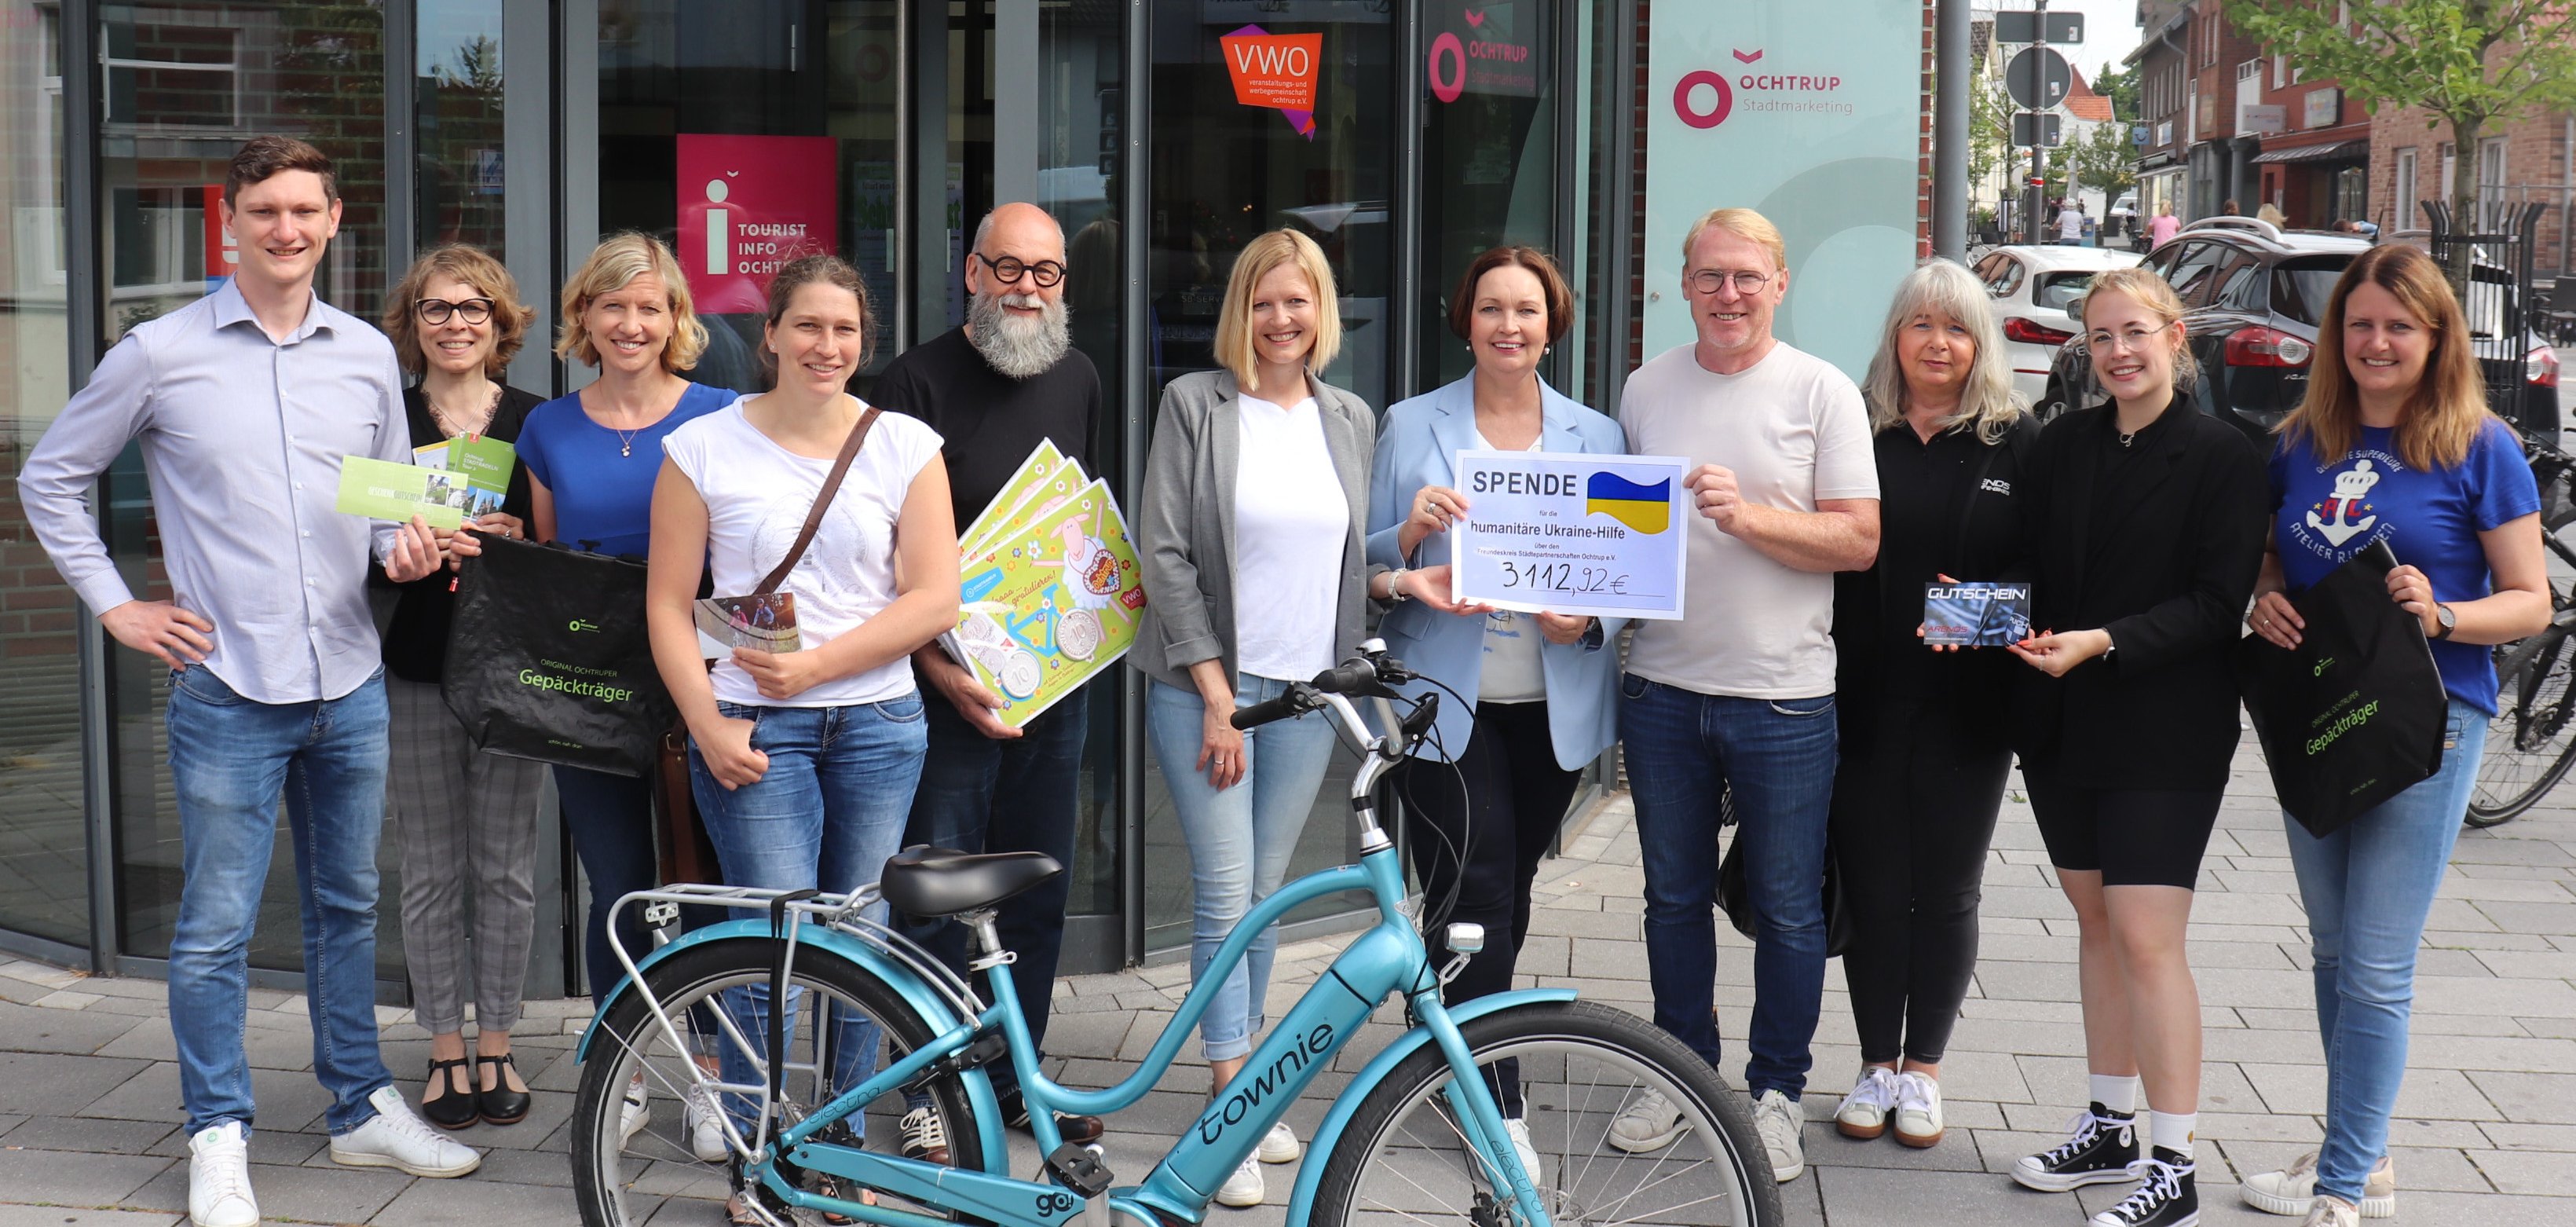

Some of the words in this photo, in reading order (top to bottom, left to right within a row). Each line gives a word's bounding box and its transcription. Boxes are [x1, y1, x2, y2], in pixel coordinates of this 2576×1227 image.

[1234, 44, 1309, 77] VWO
[1469, 40, 1528, 63] OCHTRUP
[1249, 79, 1294, 88] veranstaltungs-
[1249, 87, 1308, 96] werbegemeinschaft
[1740, 75, 1841, 91] OCHTRUP
[1744, 98, 1853, 115] Stadtmarketing
[738, 224, 807, 236] TOURIST
[738, 243, 778, 255] INFO
[738, 262, 785, 274] OCHT
[2355, 449, 2404, 473] SUPERIEURE
[1473, 471, 1577, 496] SPENDE
[1471, 520, 1541, 536] humanitäre
[1545, 524, 1626, 540] Ukraine-Hilfe
[2289, 522, 2333, 560] ATELIER
[1477, 548, 1517, 557] Freundeskreis
[1092, 558, 1114, 591] Ochtrup
[1122, 588, 1141, 604] VWO
[1927, 588, 2026, 600] GUTSCHEIN
[540, 658, 573, 672] ORIGINAL
[574, 665, 618, 677] OCHTRUPER
[518, 668, 634, 703] Gepäckträger
[2306, 699, 2379, 756] Gepäckträger
[1198, 1024, 1334, 1145] townie
[809, 1086, 880, 1124] electra
[1491, 1141, 1544, 1213] electra
